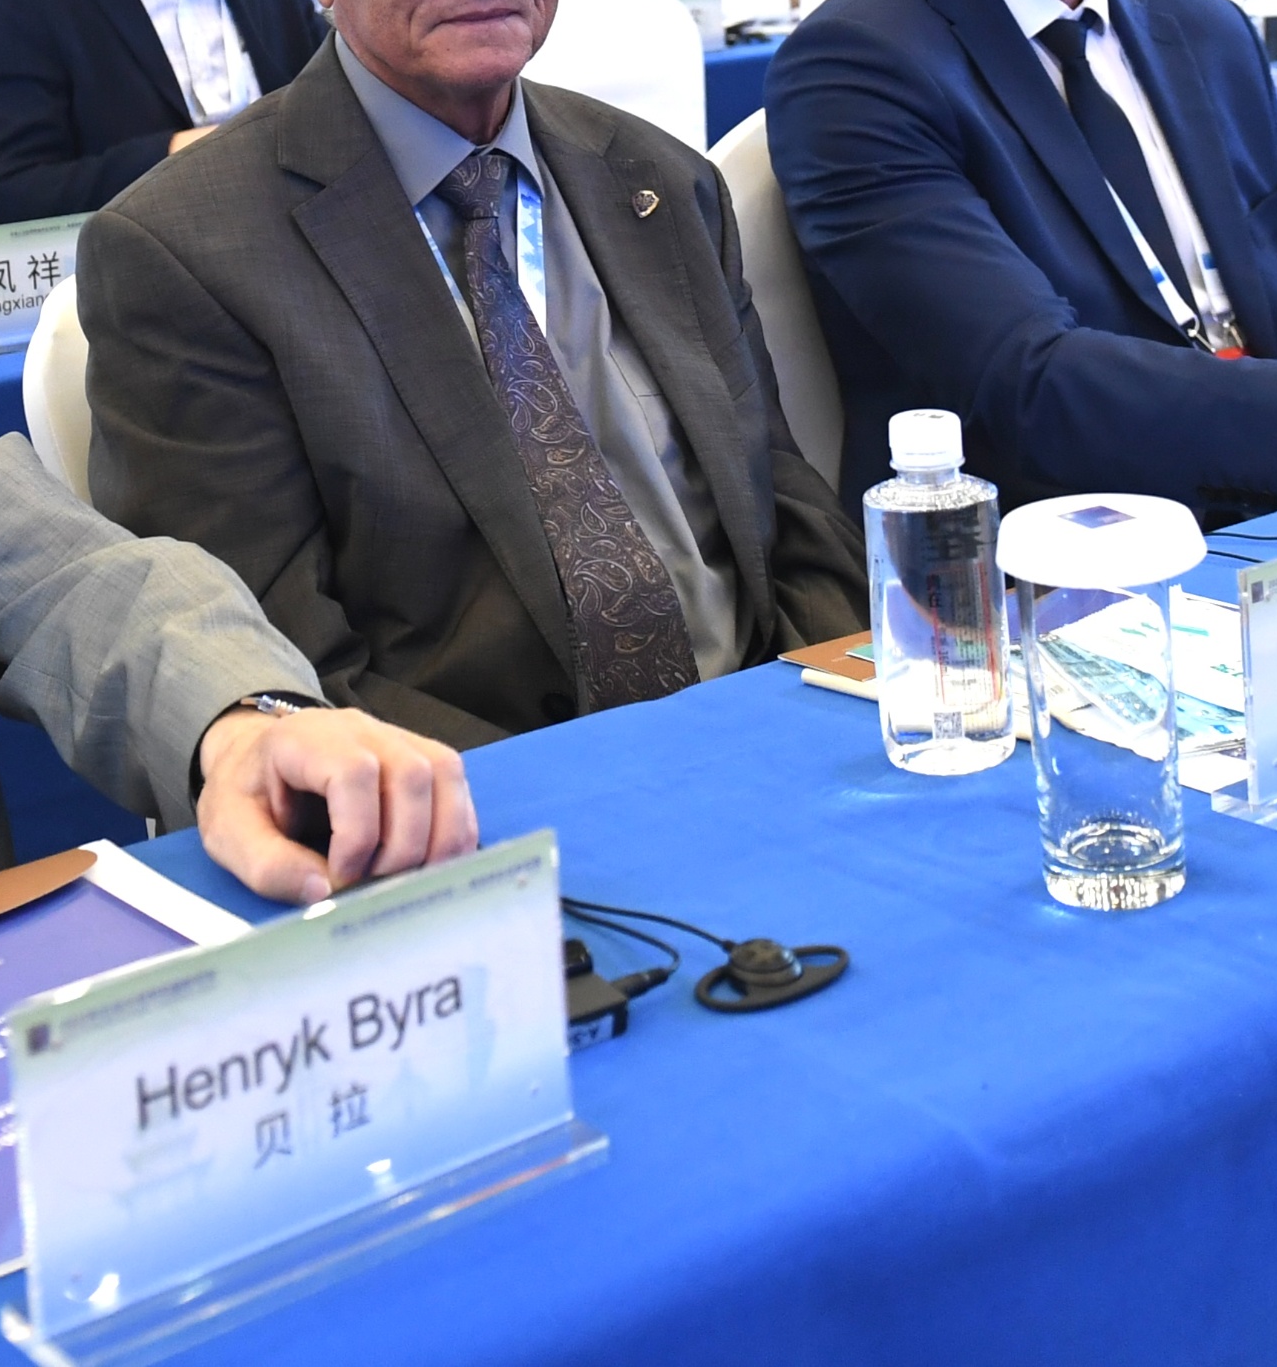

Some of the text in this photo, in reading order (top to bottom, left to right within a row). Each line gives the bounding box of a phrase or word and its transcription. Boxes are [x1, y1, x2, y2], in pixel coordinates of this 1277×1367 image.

[135, 1014, 333, 1131] Henryk
[346, 974, 464, 1057] Byra
[252, 1082, 371, 1170] 贝拉
